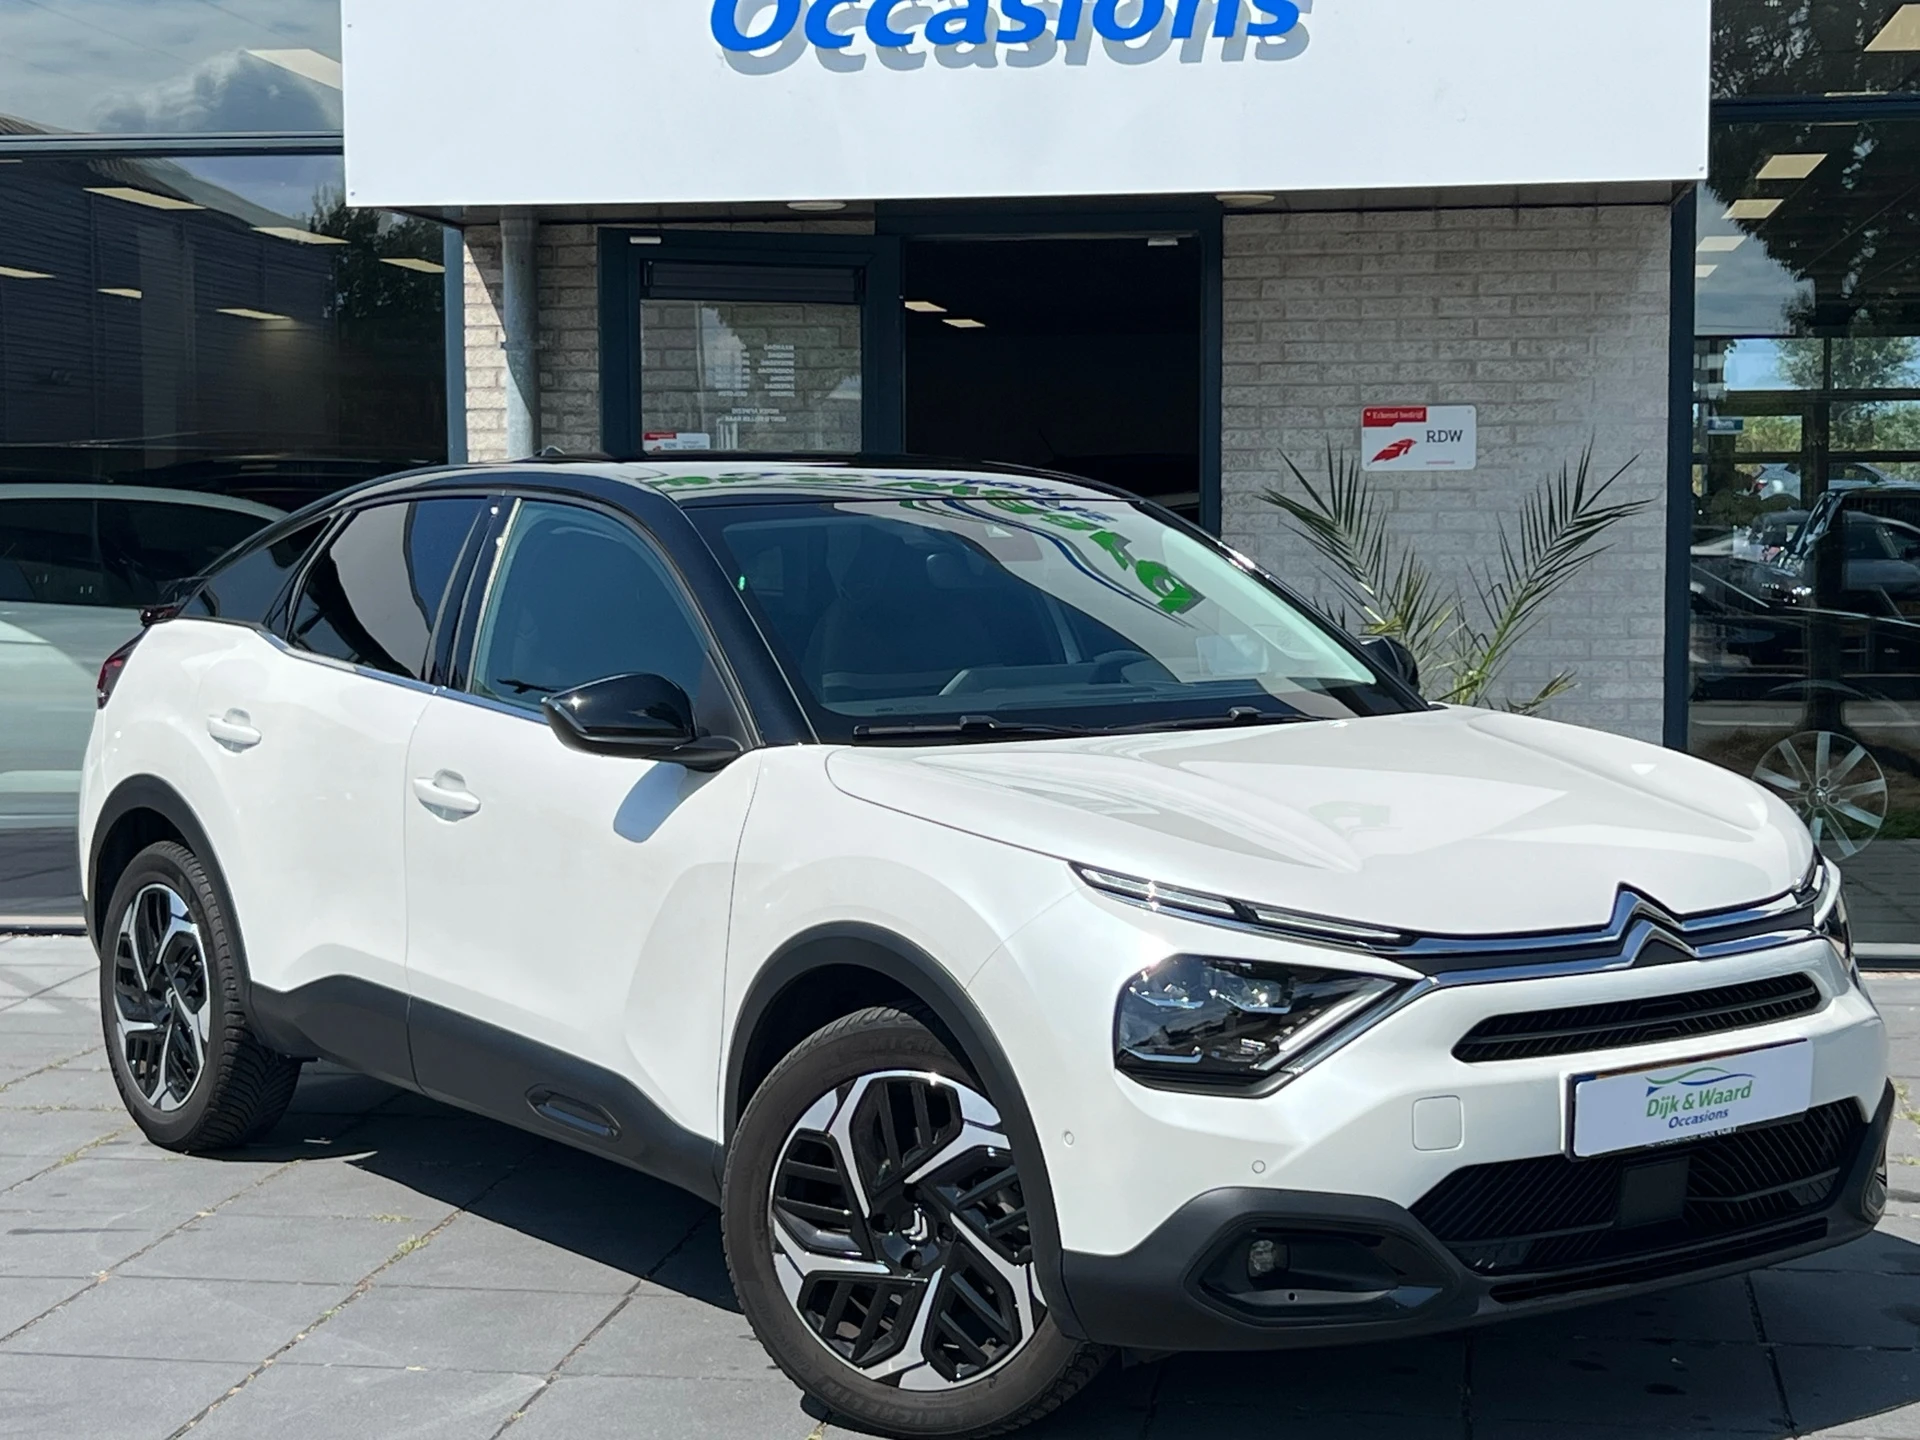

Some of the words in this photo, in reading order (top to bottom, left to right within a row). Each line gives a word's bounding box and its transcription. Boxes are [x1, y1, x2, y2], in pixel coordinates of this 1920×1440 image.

[709, 0, 1301, 52] Occasions
[1425, 430, 1463, 443] RDW
[1646, 1094, 1679, 1119] Dijk
[1682, 1093, 1694, 1110] &
[1699, 1080, 1753, 1108] Waard
[1669, 1109, 1729, 1128] Occasions
